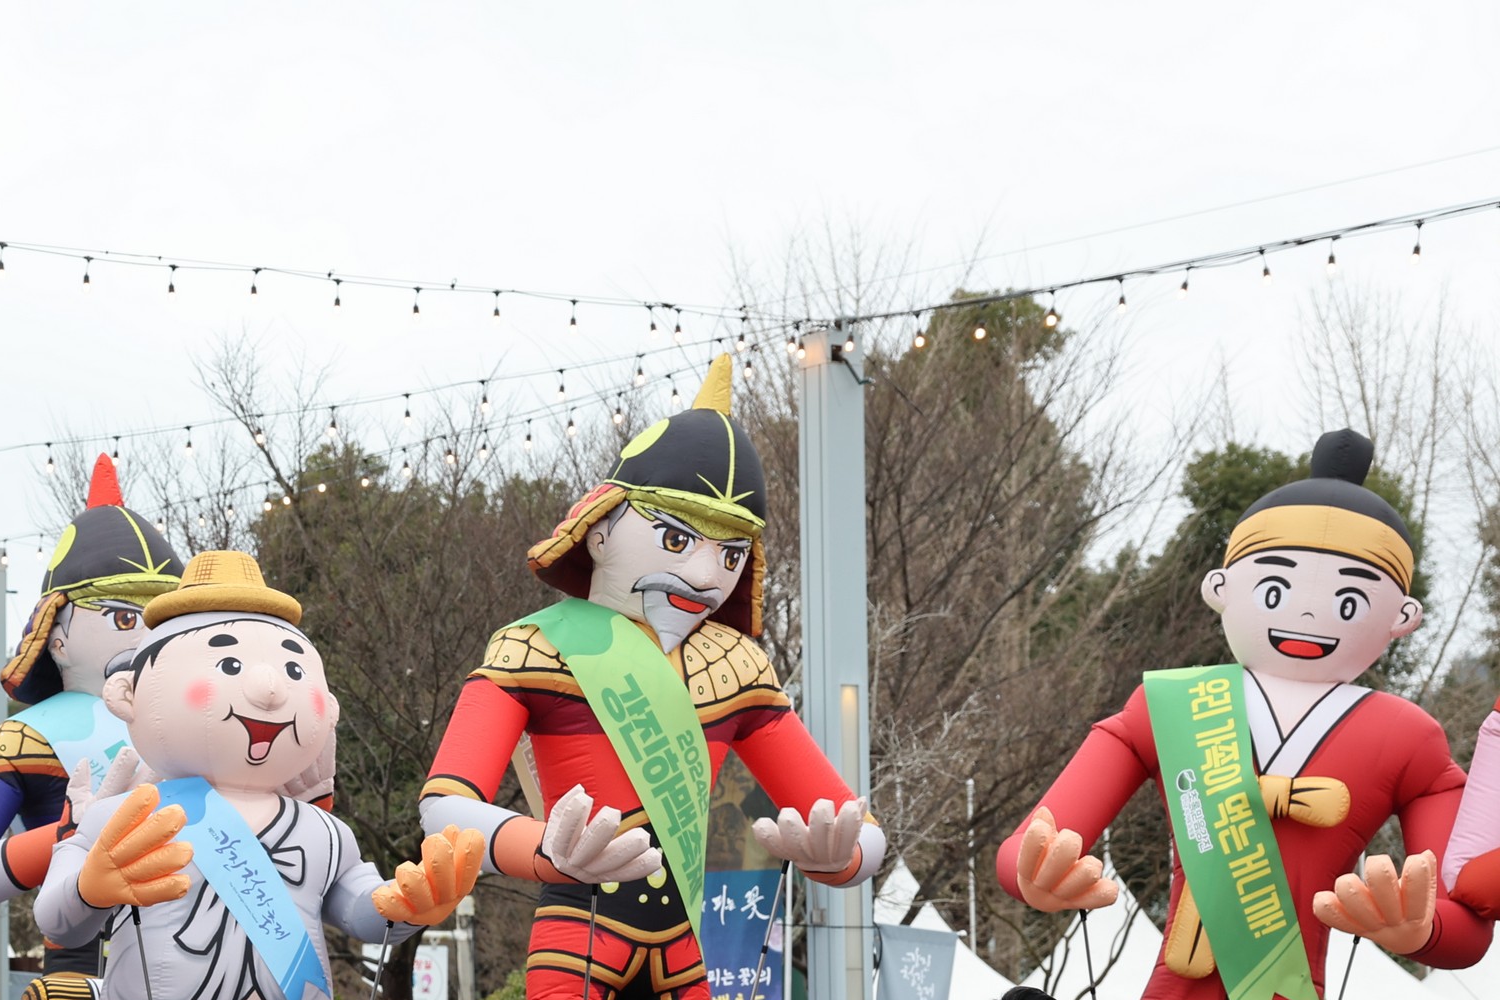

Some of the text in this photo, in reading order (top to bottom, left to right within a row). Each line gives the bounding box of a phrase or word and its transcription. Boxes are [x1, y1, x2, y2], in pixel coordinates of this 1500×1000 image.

[1188, 678, 1233, 721] 우리
[601, 672, 703, 908] 강진하맥축제
[1195, 718, 1243, 797] 가족이
